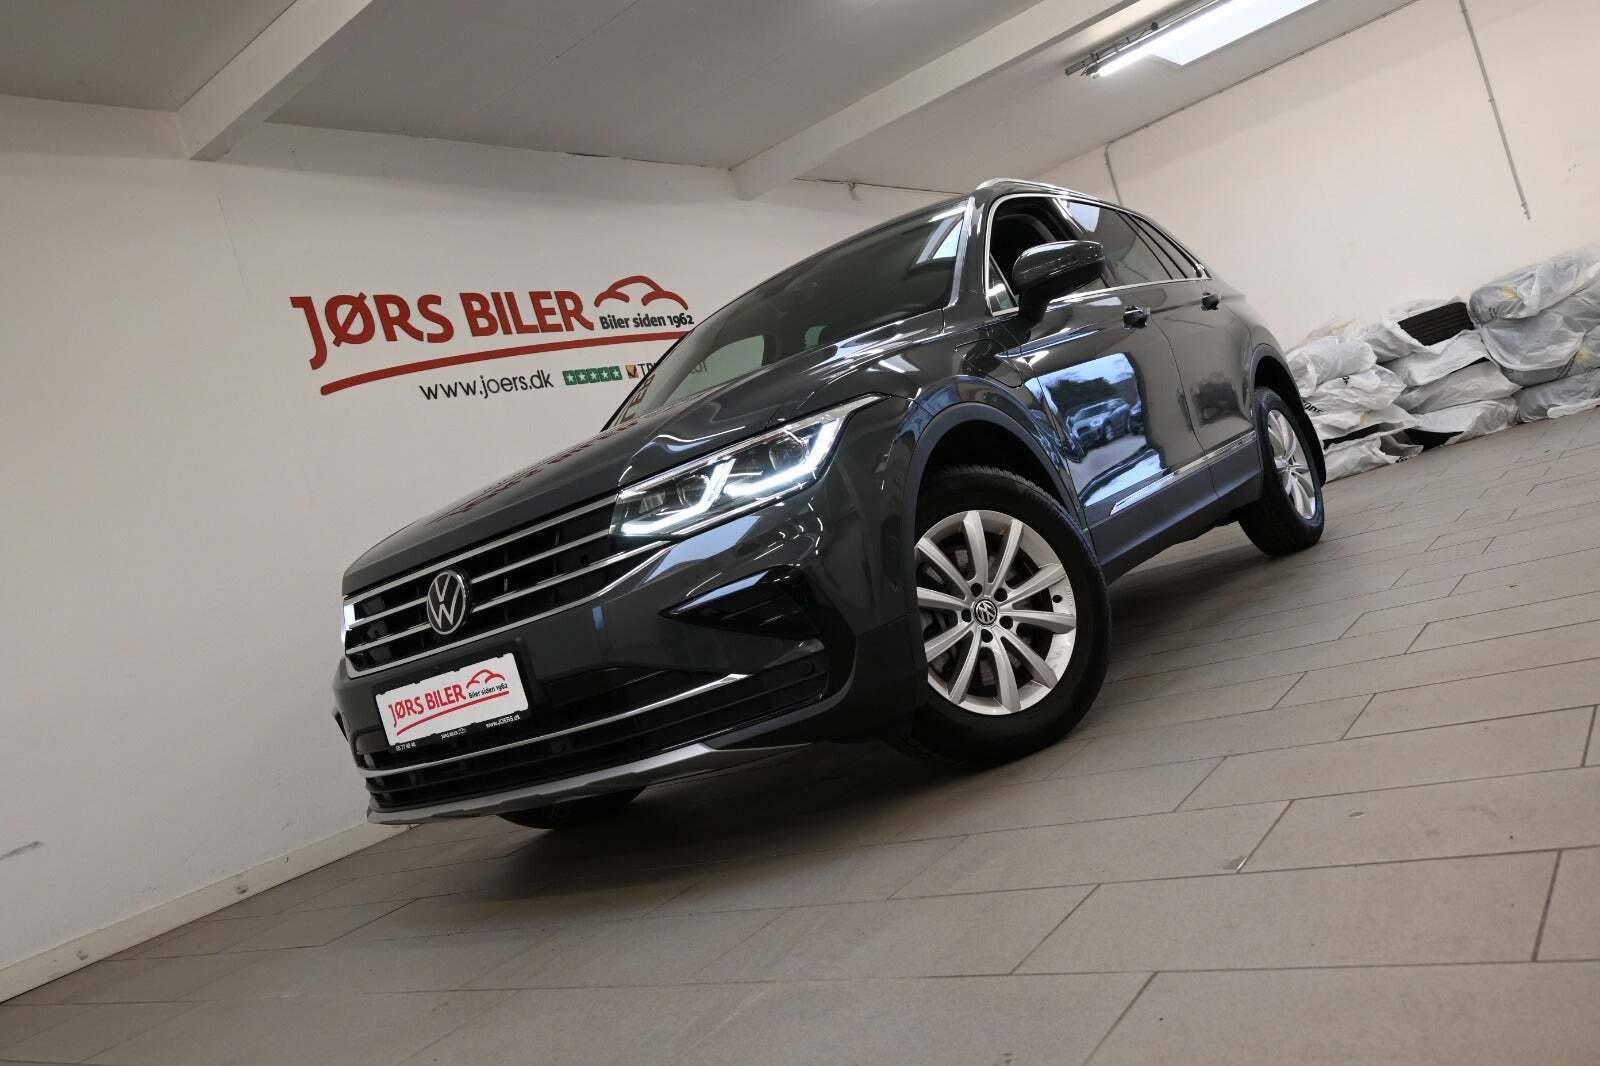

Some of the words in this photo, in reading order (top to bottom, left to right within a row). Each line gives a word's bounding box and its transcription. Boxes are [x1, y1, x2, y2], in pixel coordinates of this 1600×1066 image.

[289, 292, 455, 370] JØRS
[459, 290, 595, 337] BILER
[599, 314, 630, 330] Biler
[633, 313, 666, 328] siden
[667, 312, 695, 329] 1962
[419, 369, 555, 401] www.joers.dk
[387, 696, 425, 729] JØRS
[425, 683, 467, 711] BILER
